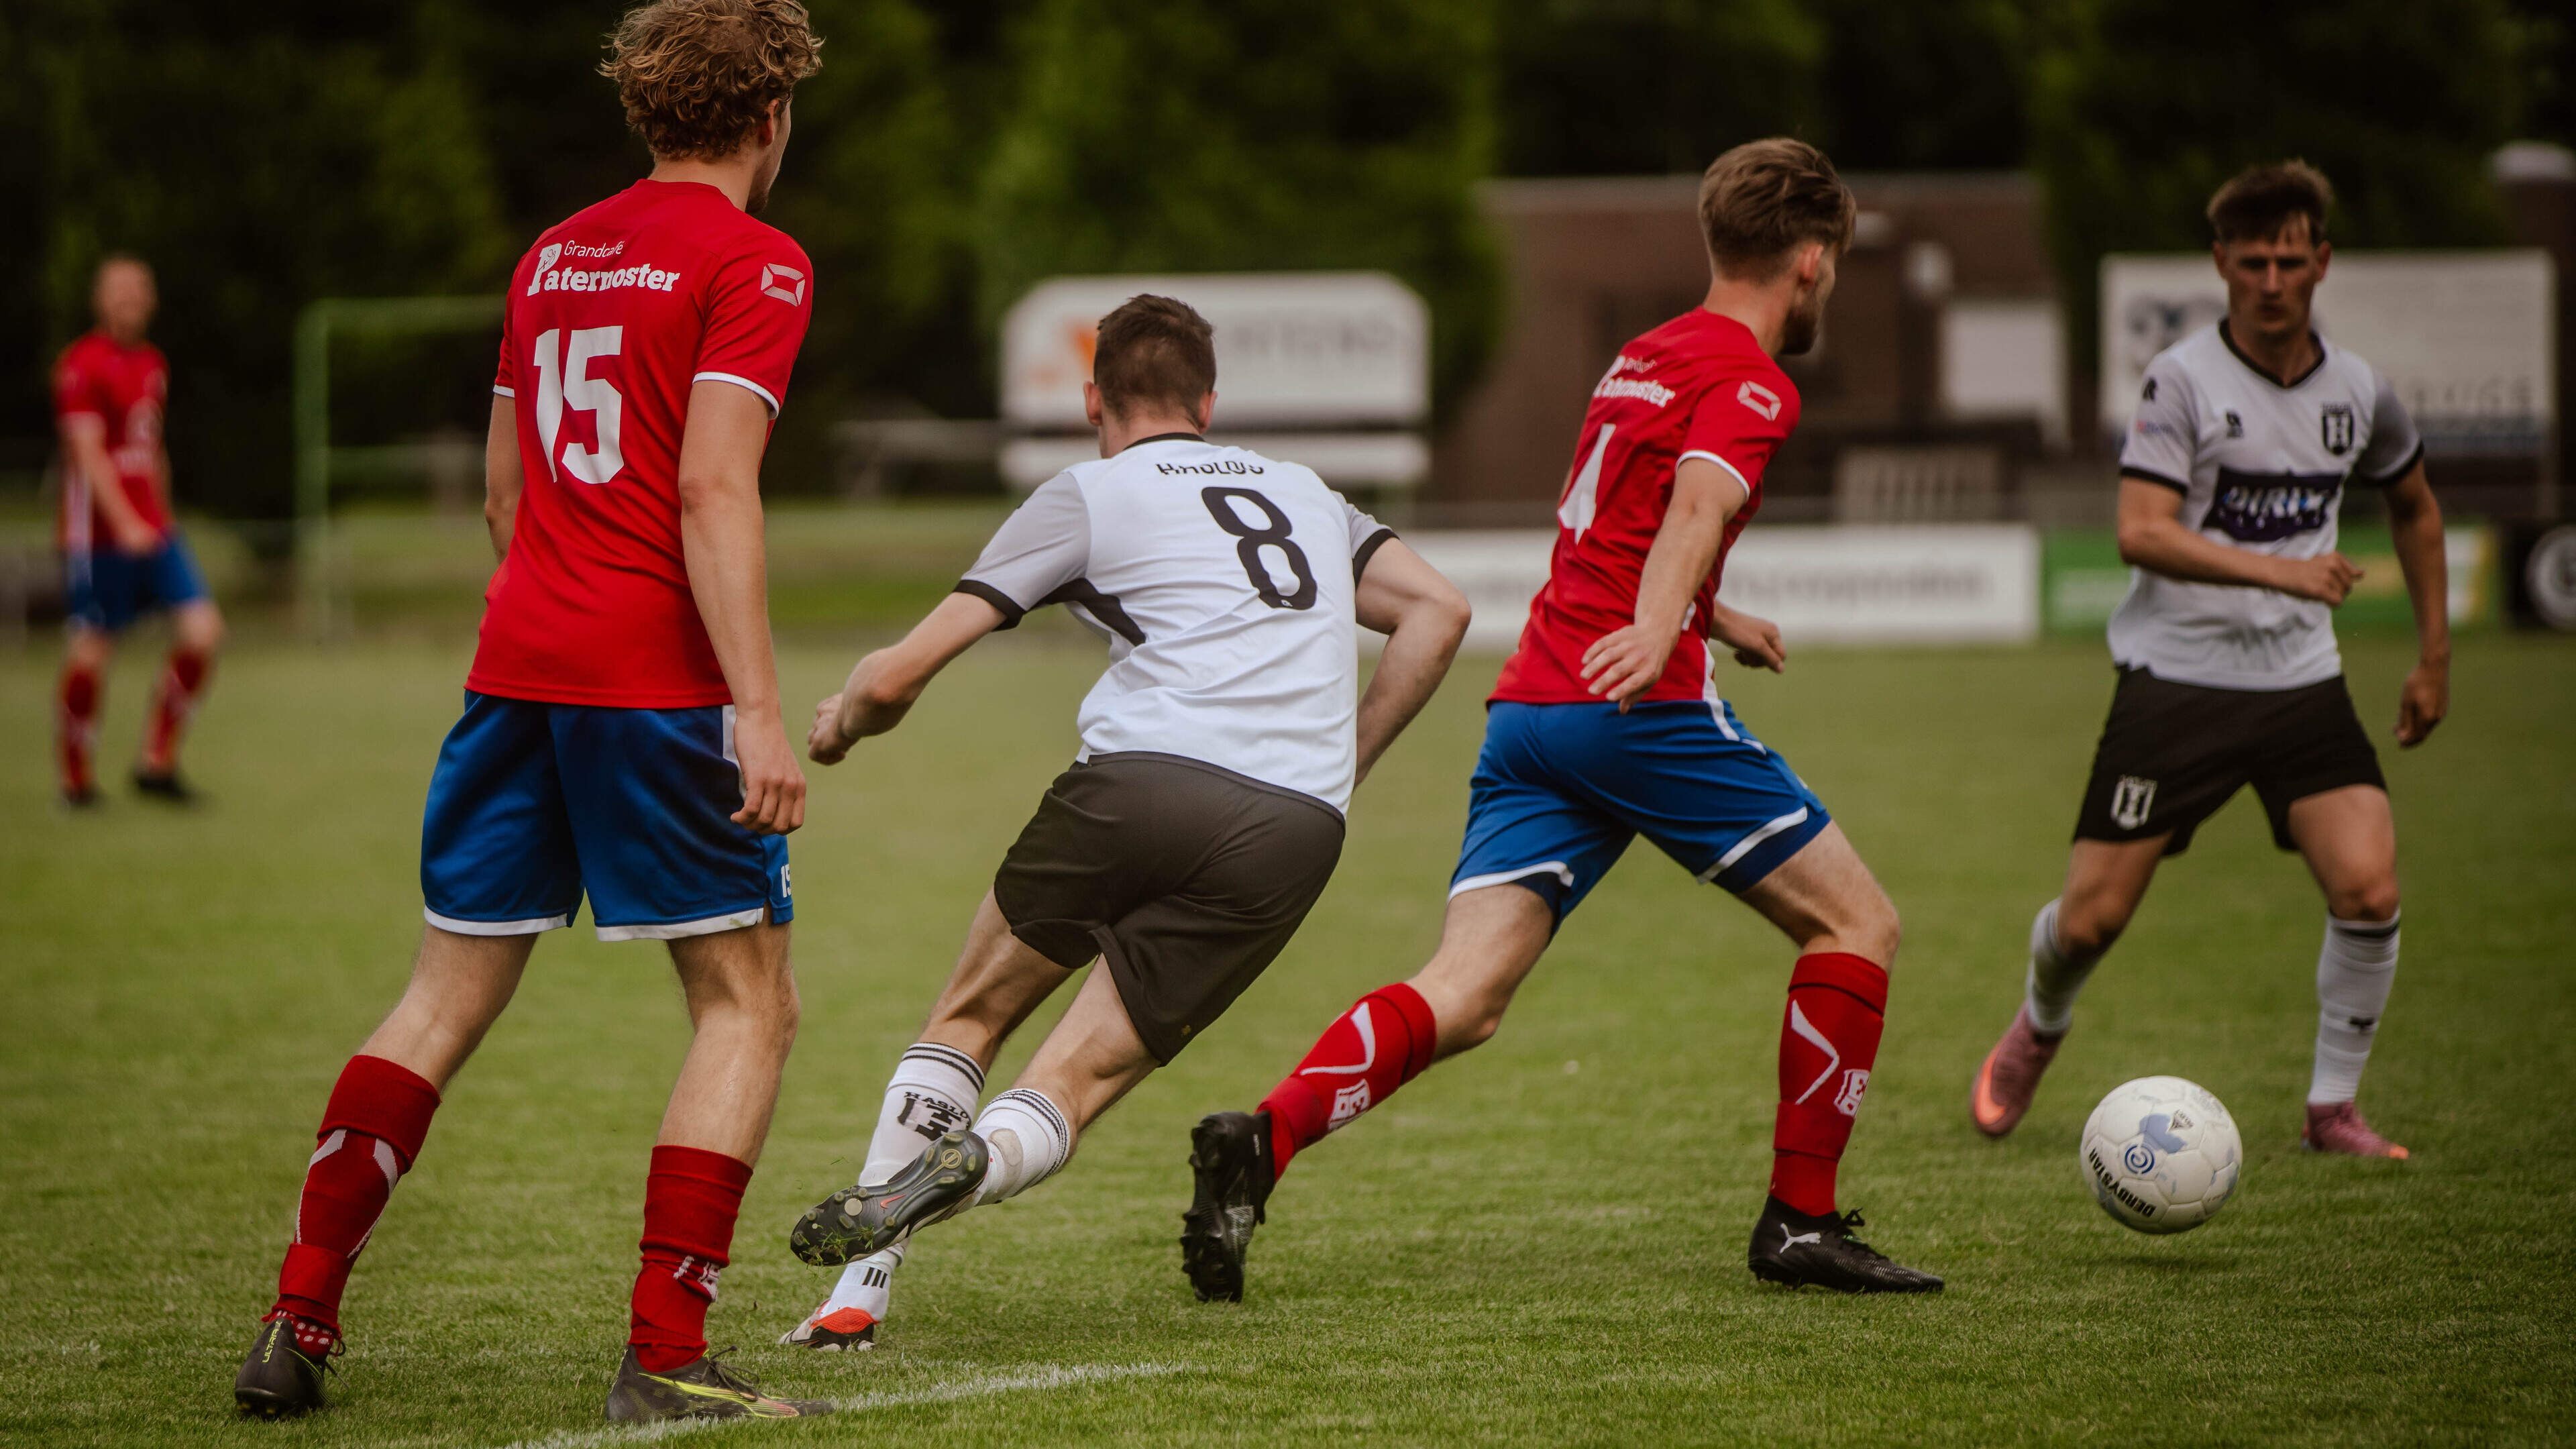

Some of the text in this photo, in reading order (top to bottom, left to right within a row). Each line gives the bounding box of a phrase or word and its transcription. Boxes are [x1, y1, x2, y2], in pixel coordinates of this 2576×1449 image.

[527, 243, 681, 297] Paternoster
[564, 239, 626, 258] Grandcafé
[533, 325, 625, 484] 15
[1558, 423, 1617, 546] 4
[1201, 486, 1318, 610] 8
[2088, 1146, 2157, 1218] DERBYSTAR
[262, 1328, 280, 1363] ULTRA
